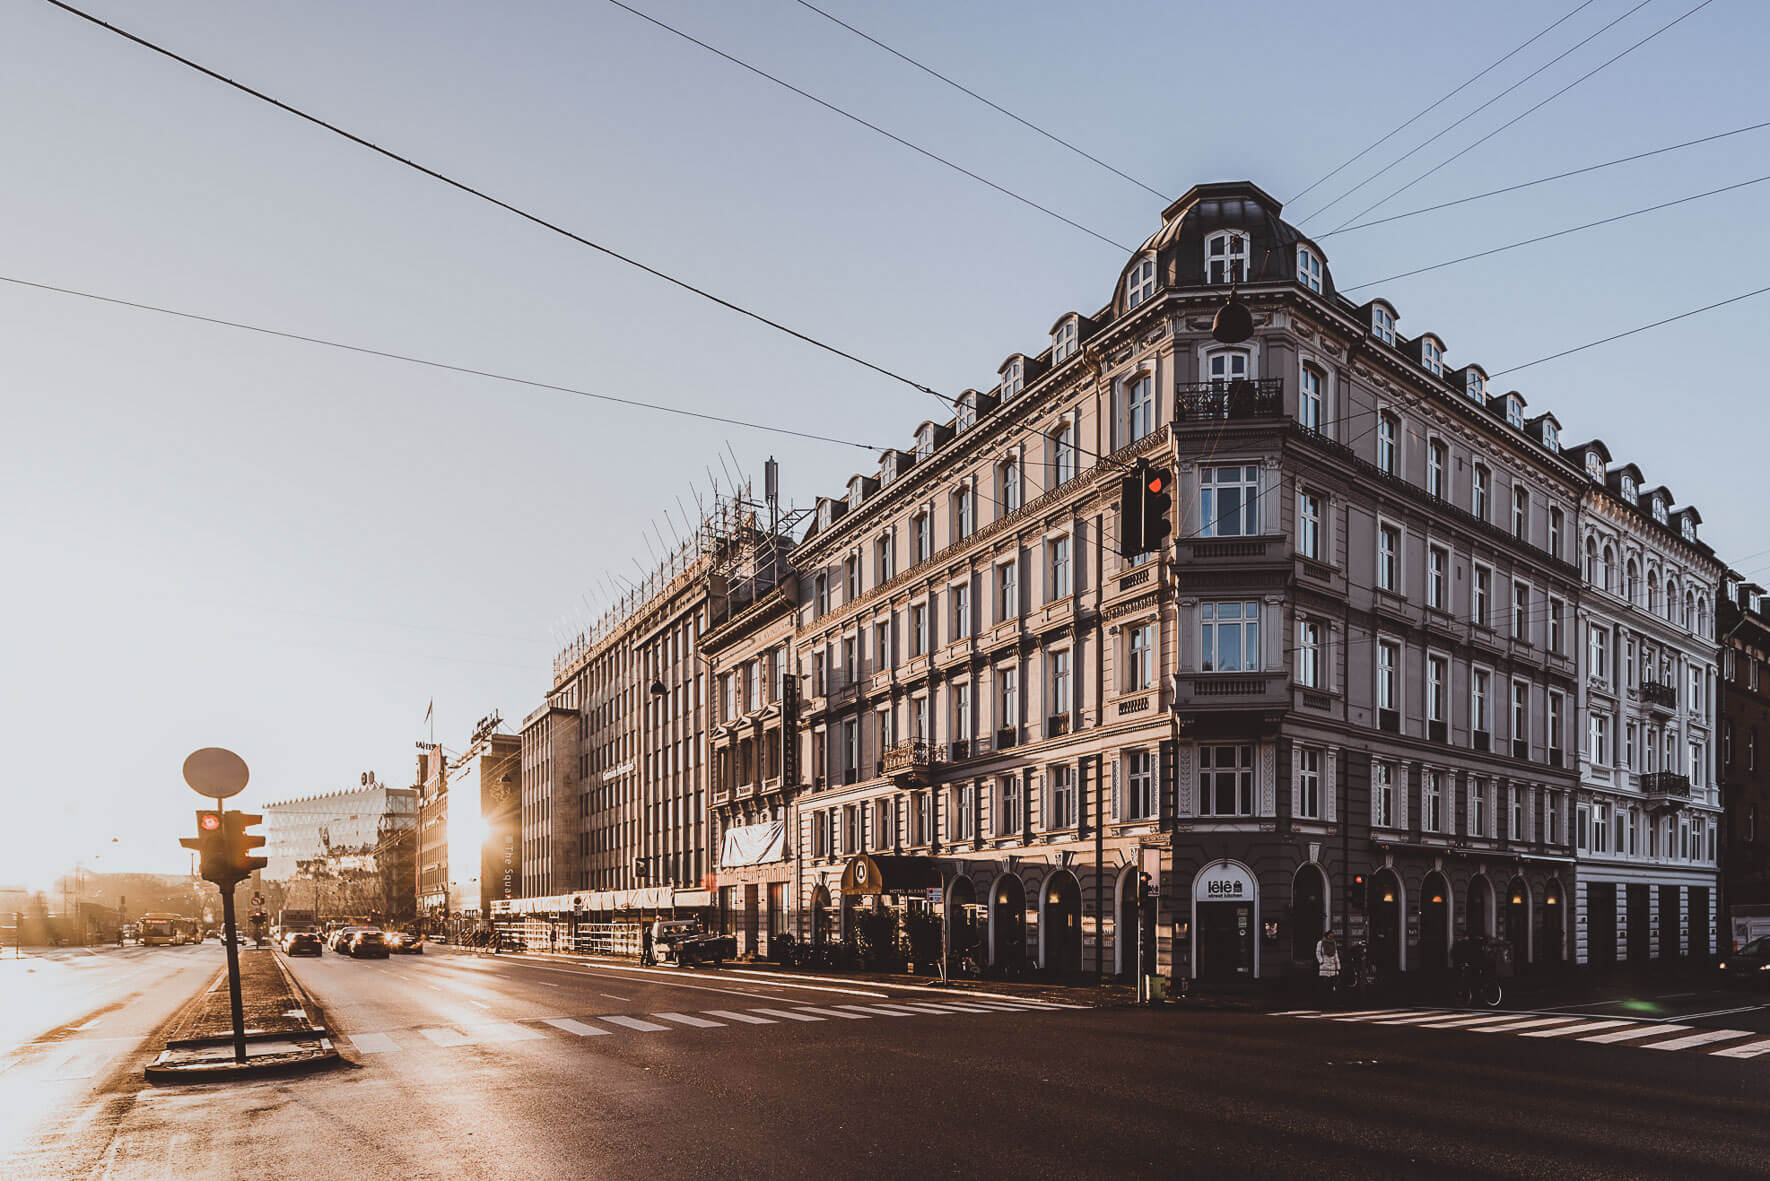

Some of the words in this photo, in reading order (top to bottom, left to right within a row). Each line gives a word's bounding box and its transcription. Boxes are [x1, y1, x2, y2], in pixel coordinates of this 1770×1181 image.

[504, 847, 513, 865] The
[503, 868, 513, 898] Squa
[1208, 880, 1232, 893] lêlê
